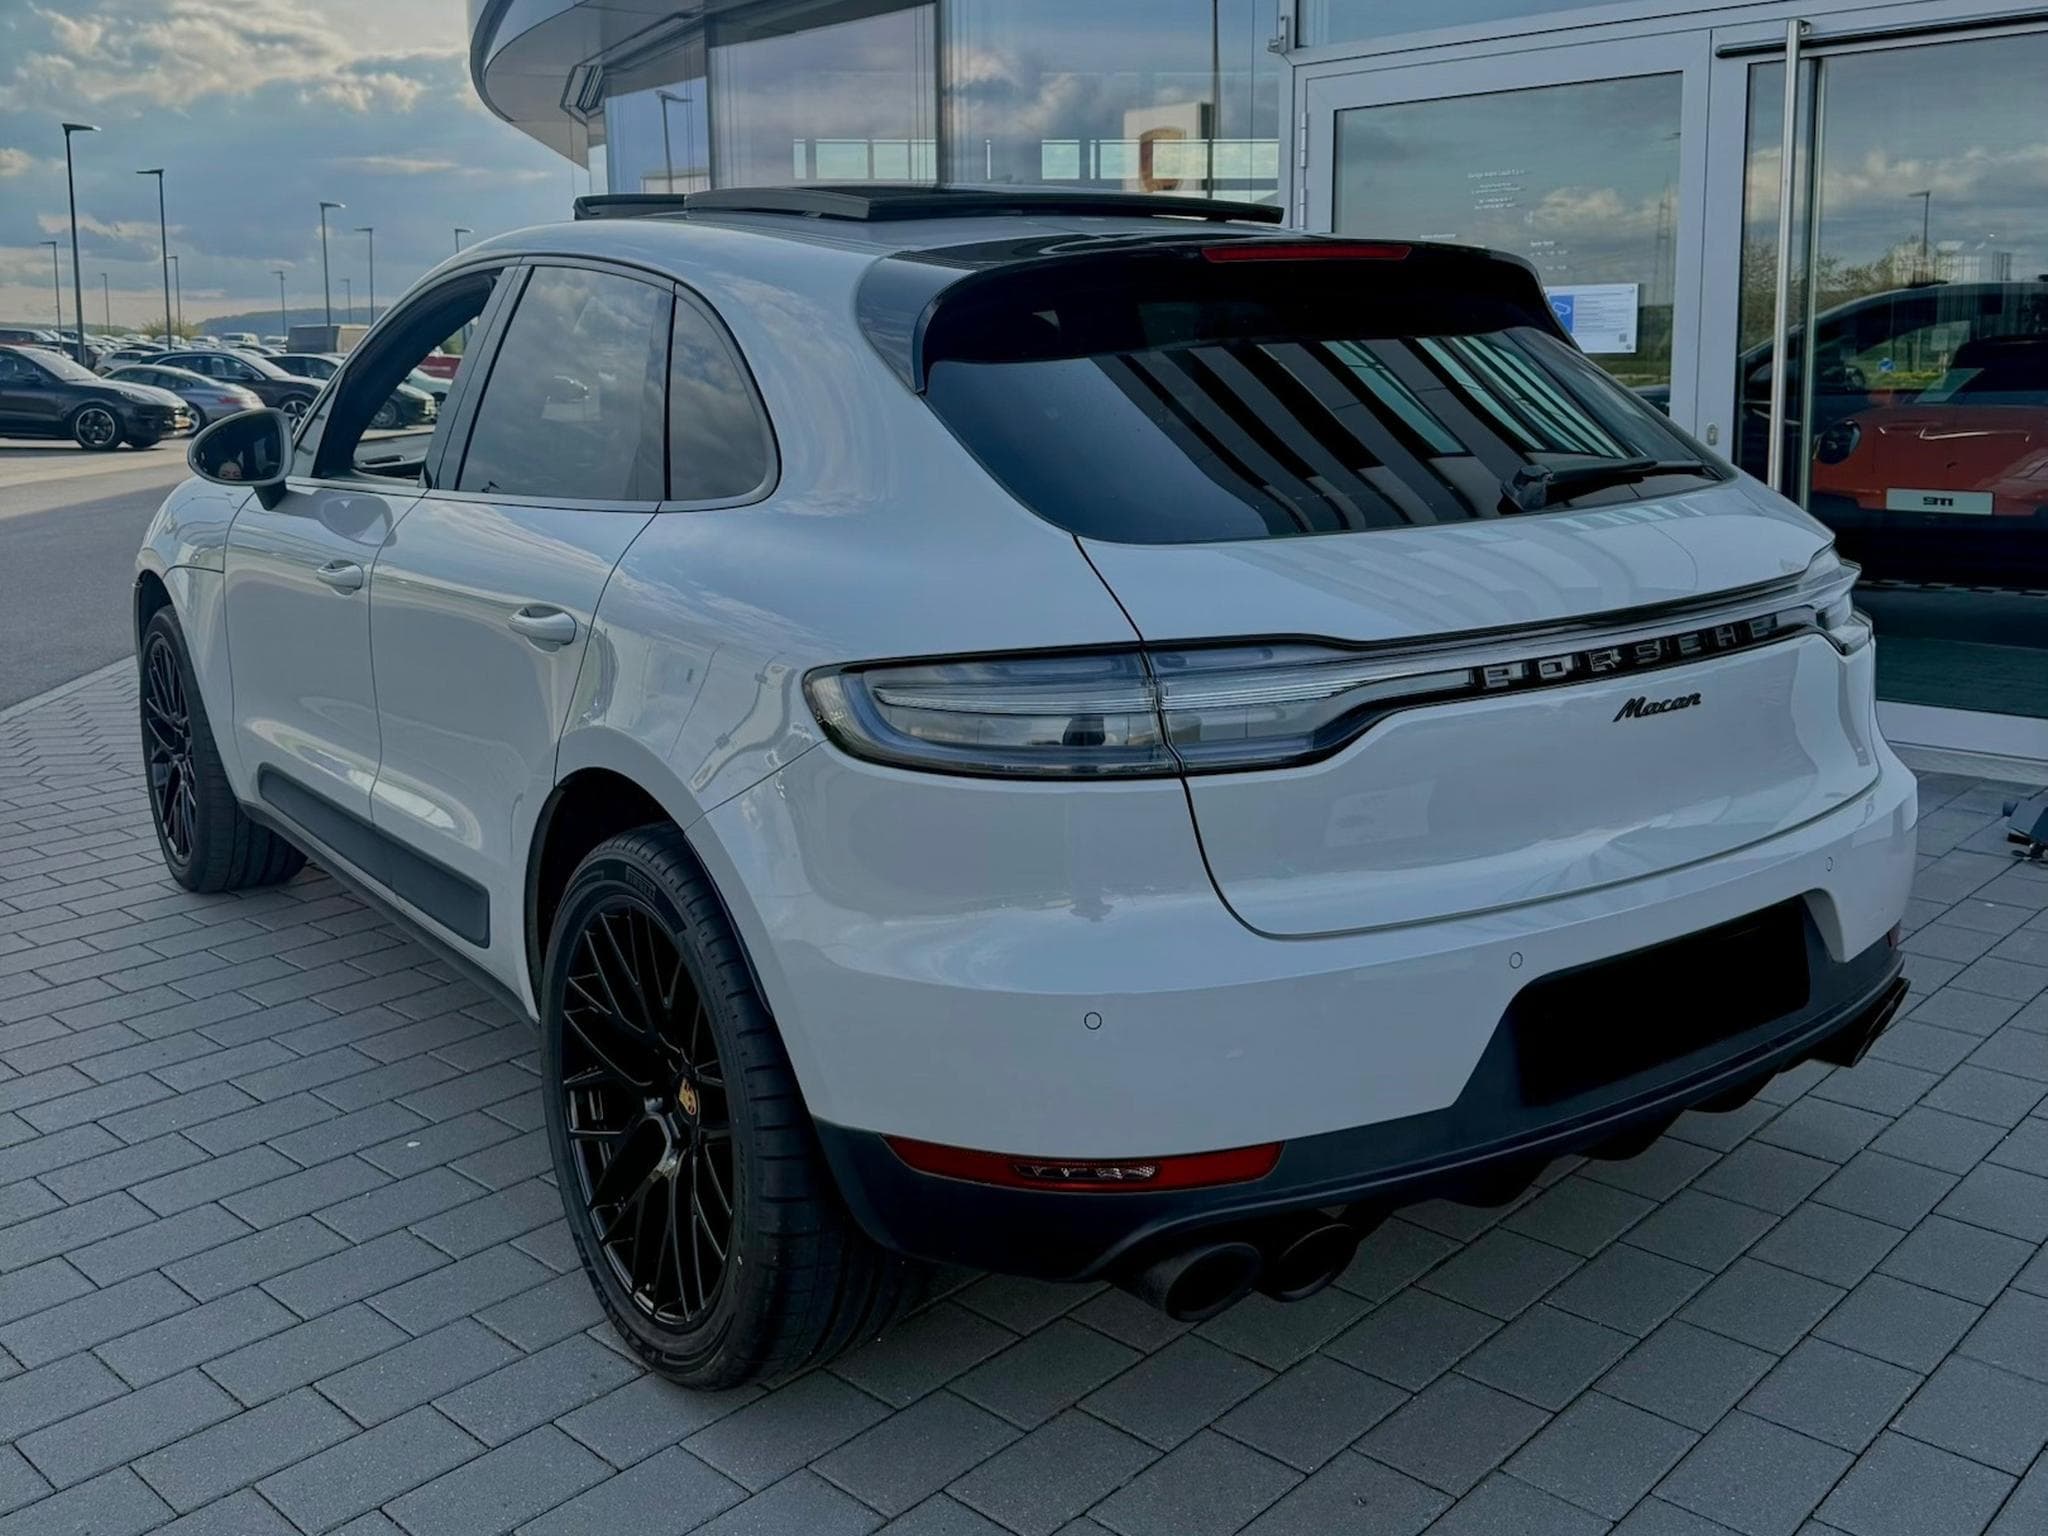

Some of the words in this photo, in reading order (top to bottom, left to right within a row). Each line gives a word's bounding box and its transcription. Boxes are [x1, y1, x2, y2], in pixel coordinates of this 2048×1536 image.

[1923, 496, 1954, 506] 911
[1482, 614, 1778, 689] PORSCHE
[1613, 692, 1702, 722] Macan
